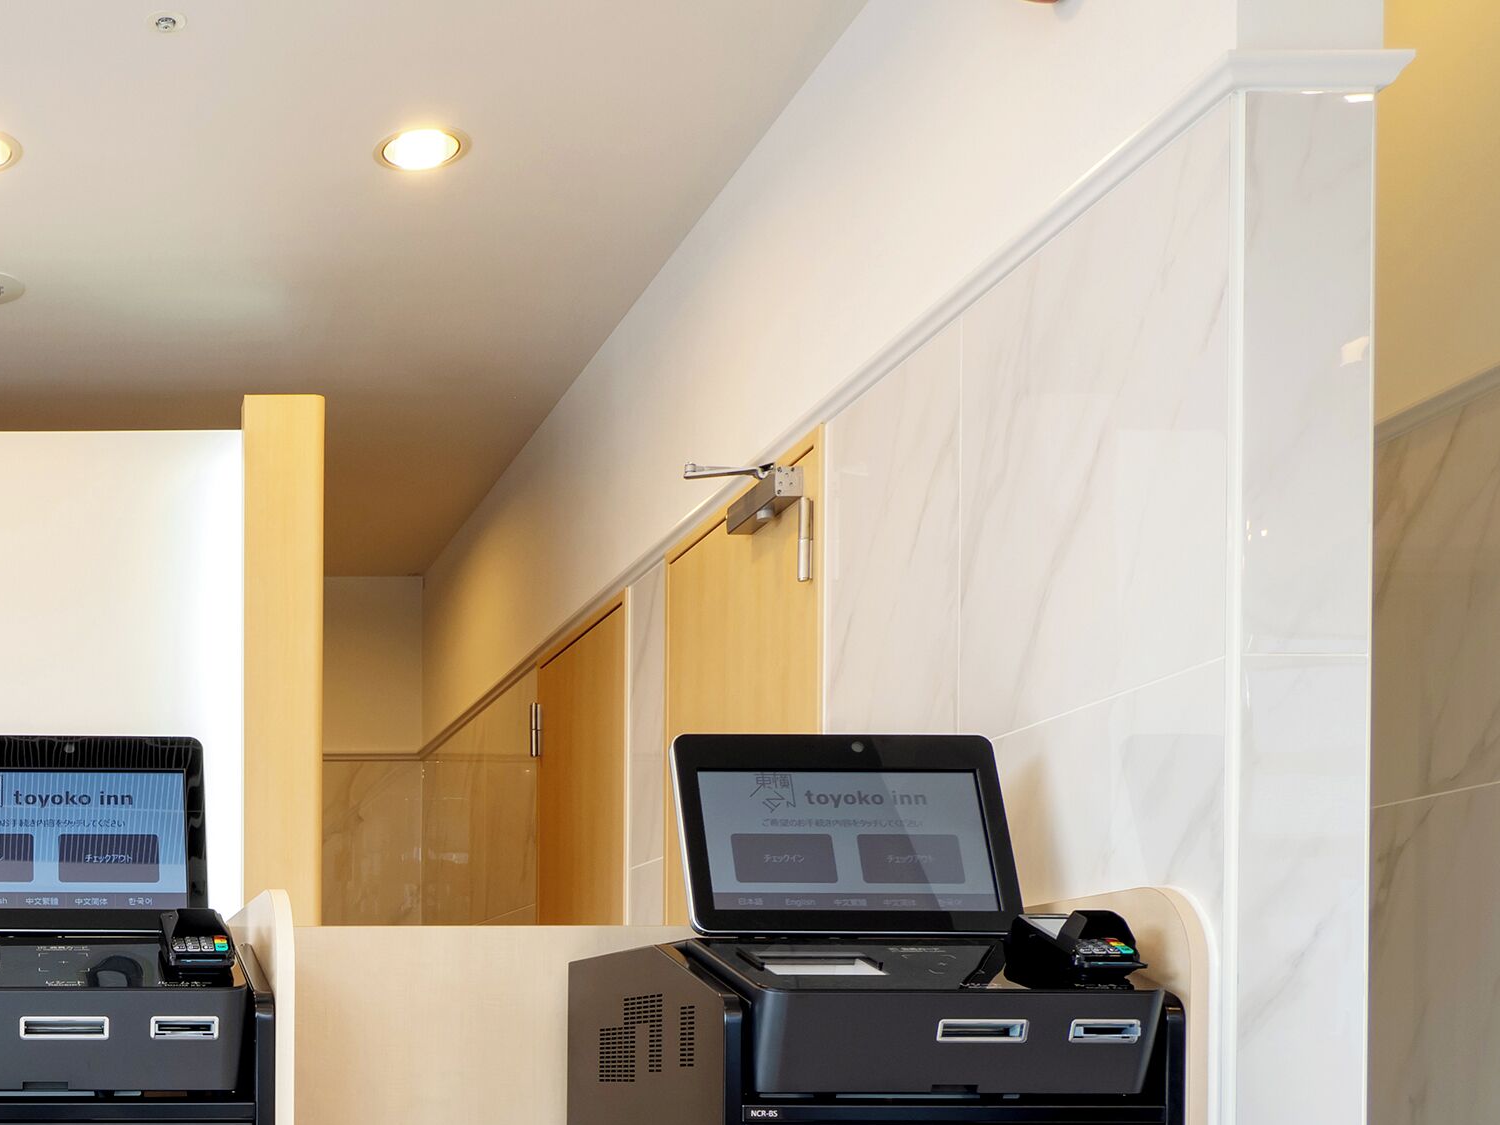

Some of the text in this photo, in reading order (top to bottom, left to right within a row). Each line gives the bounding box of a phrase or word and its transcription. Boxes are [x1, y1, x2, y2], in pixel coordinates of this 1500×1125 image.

[13, 790, 134, 809] toyoko inn
[805, 789, 927, 809] toyoko inn
